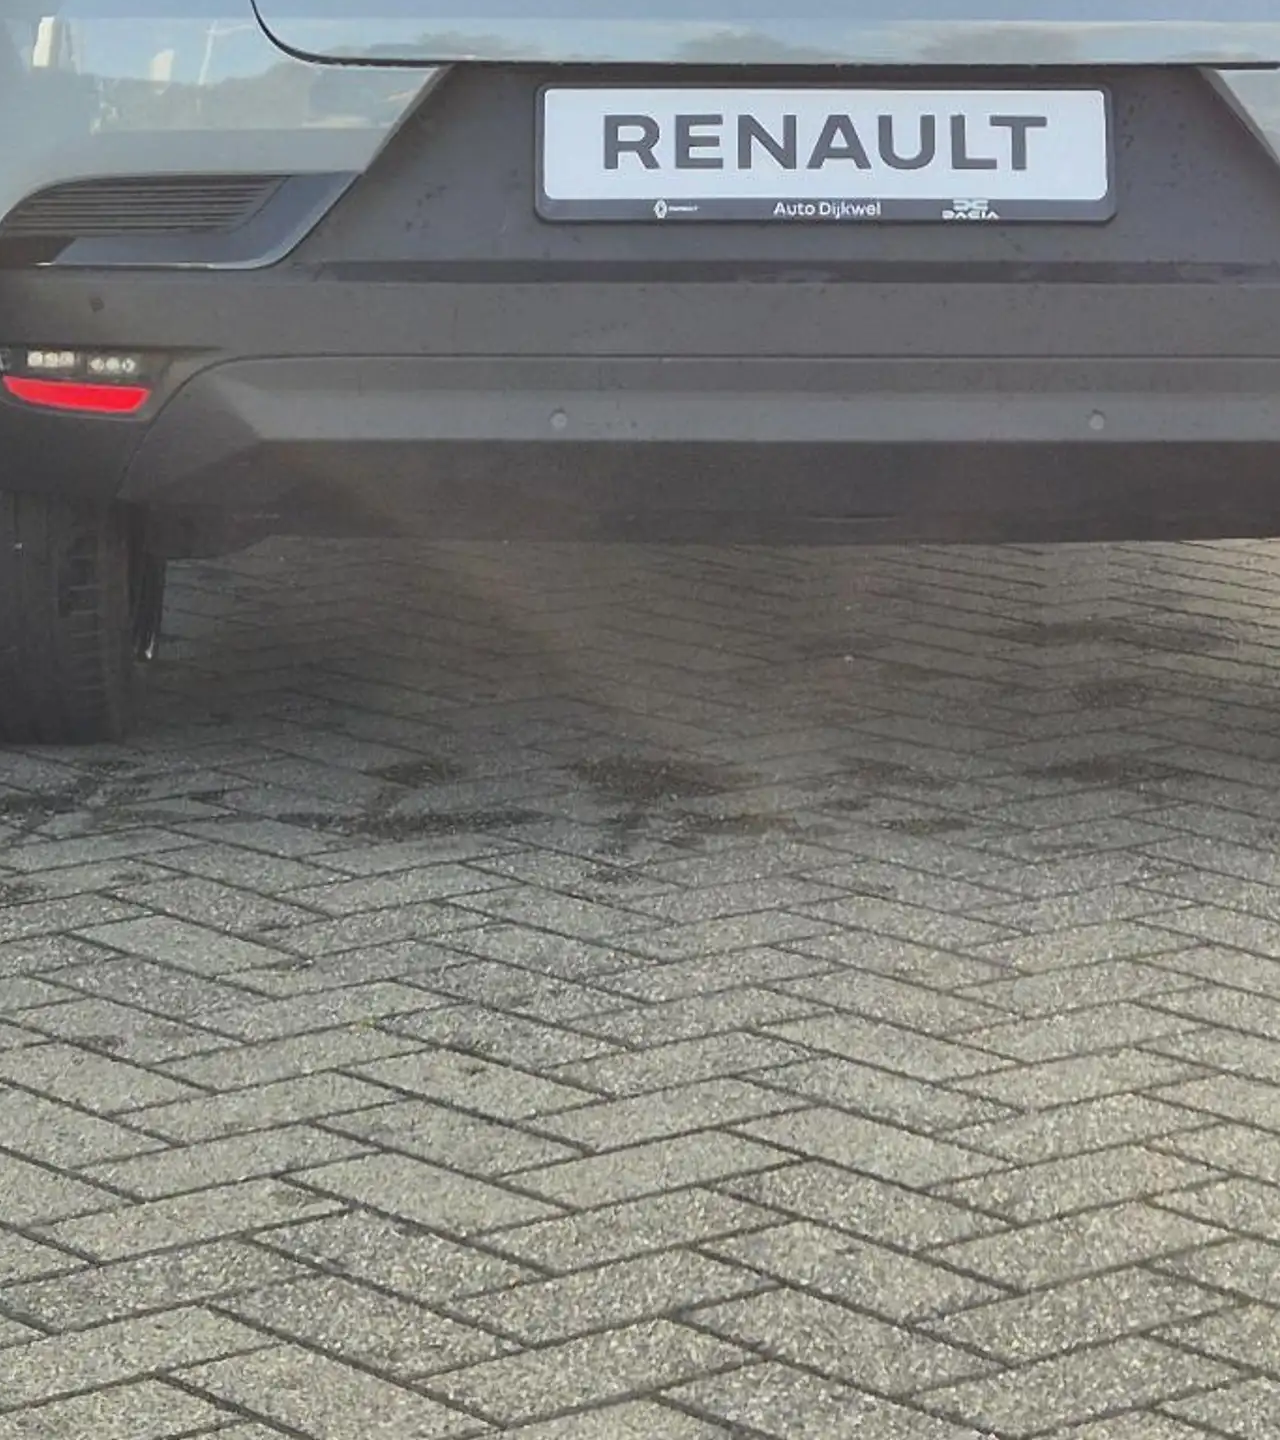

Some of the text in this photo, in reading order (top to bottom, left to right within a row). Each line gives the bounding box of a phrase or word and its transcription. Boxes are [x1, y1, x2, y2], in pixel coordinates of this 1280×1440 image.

[603, 114, 1048, 171] RENAULT
[773, 201, 882, 220] Auto Dijkwel
